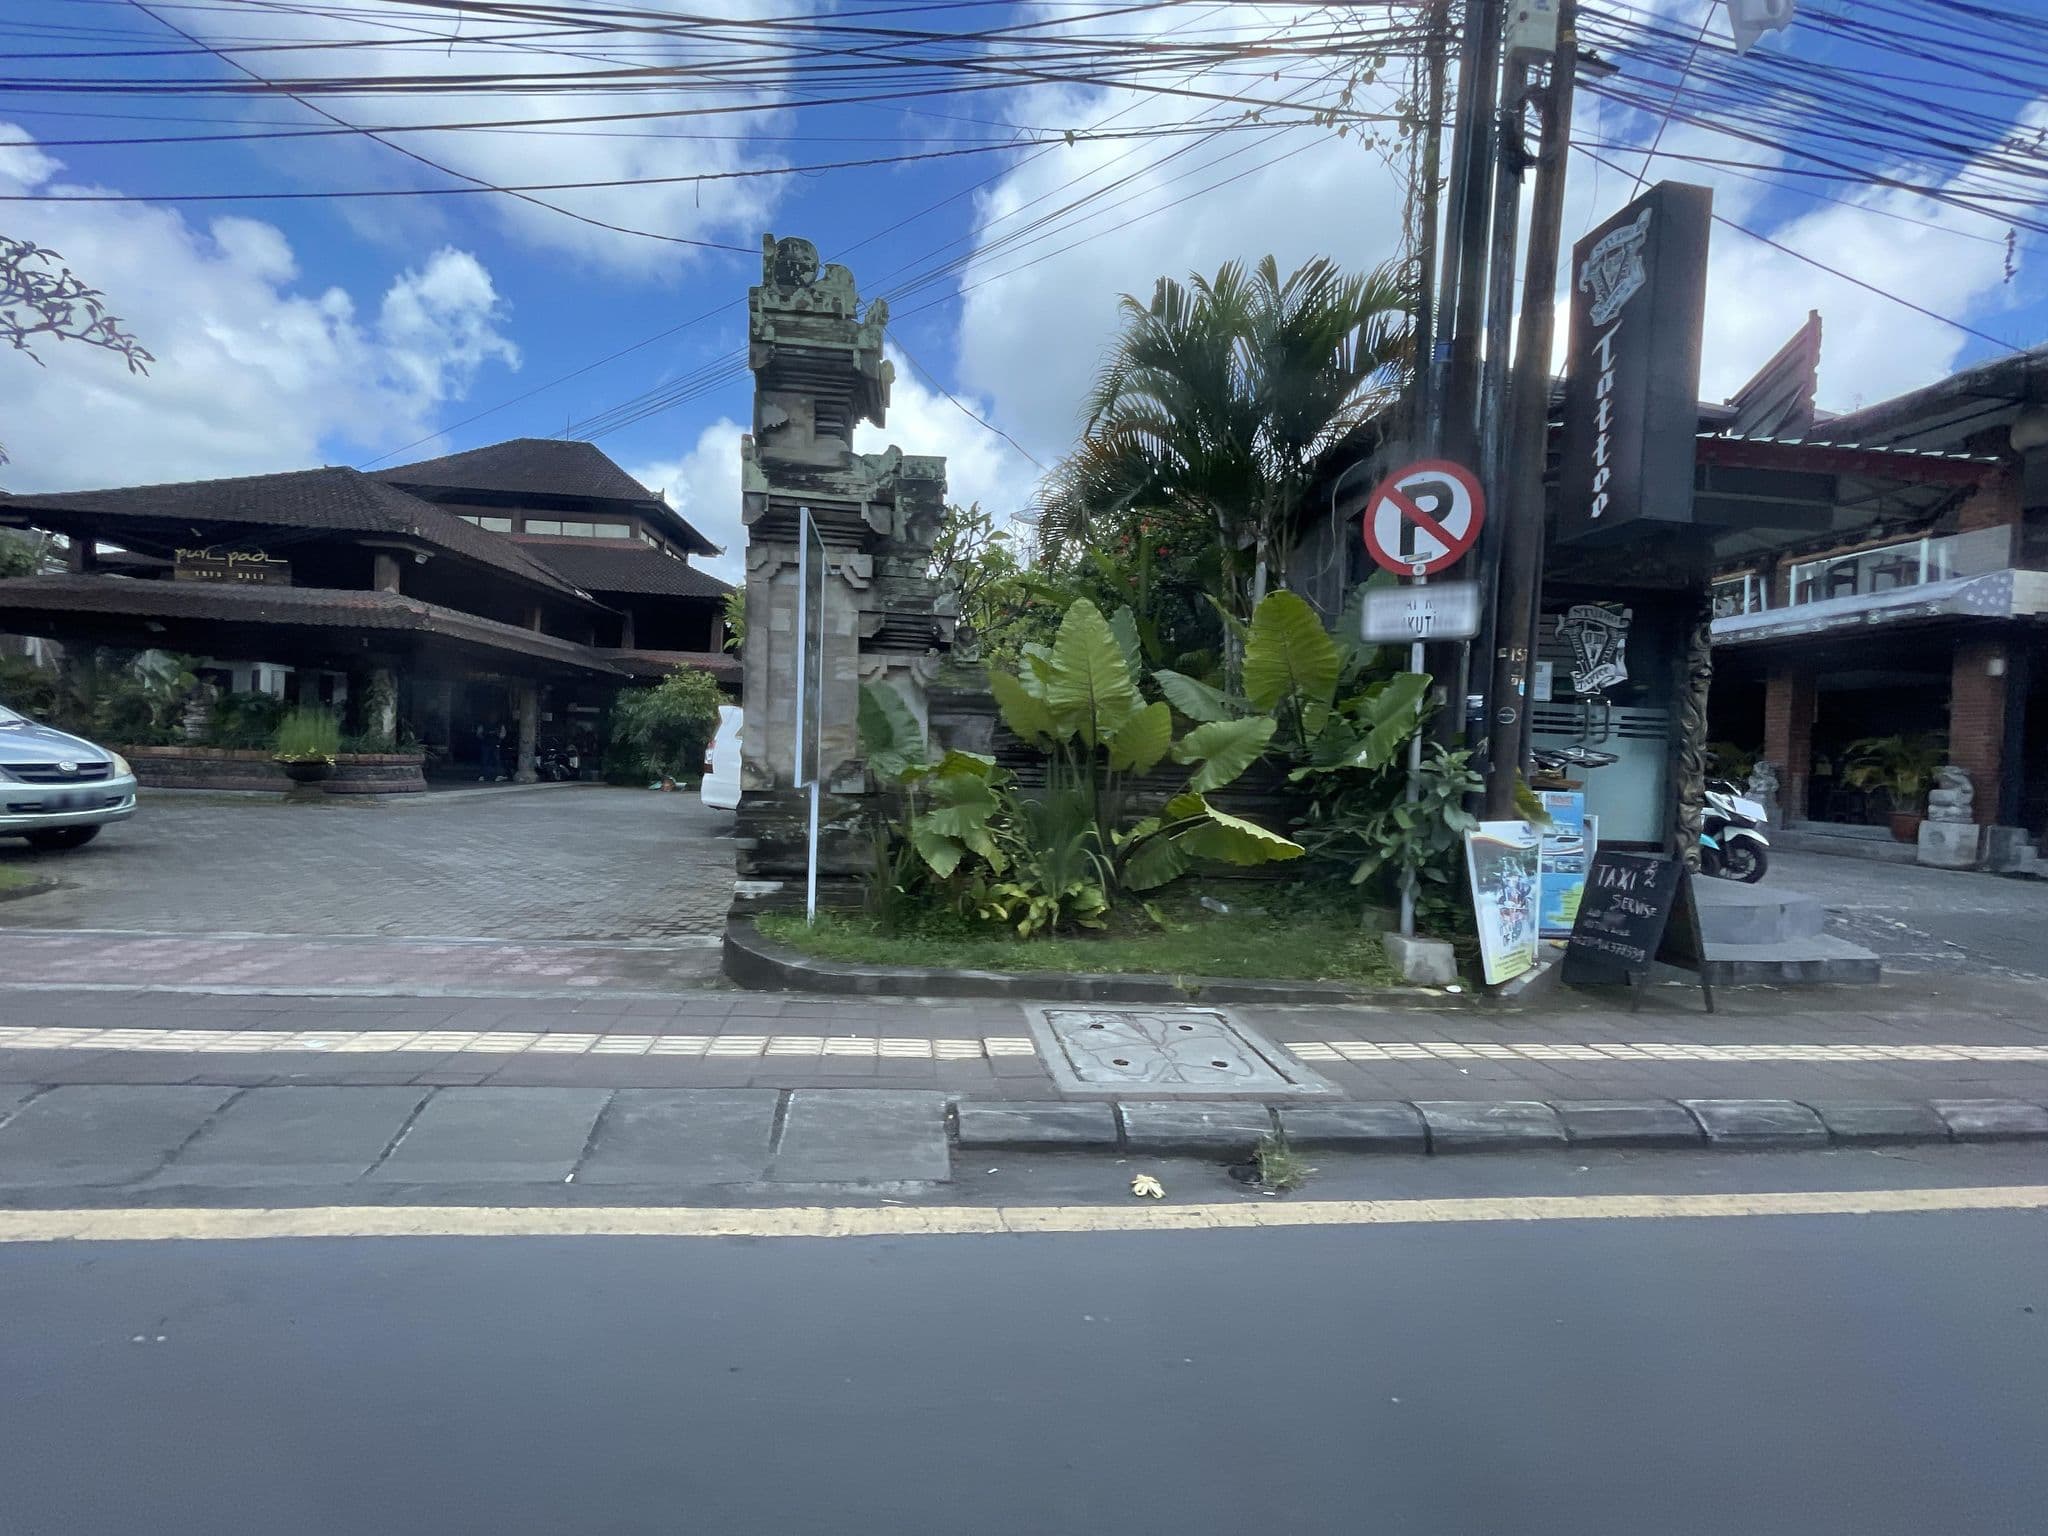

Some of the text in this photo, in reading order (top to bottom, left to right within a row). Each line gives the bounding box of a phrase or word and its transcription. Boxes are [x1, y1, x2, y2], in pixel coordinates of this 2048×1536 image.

[1591, 318, 1623, 518] Tattoo
[1400, 481, 1454, 556] P
[1598, 864, 1637, 890] TAXI
